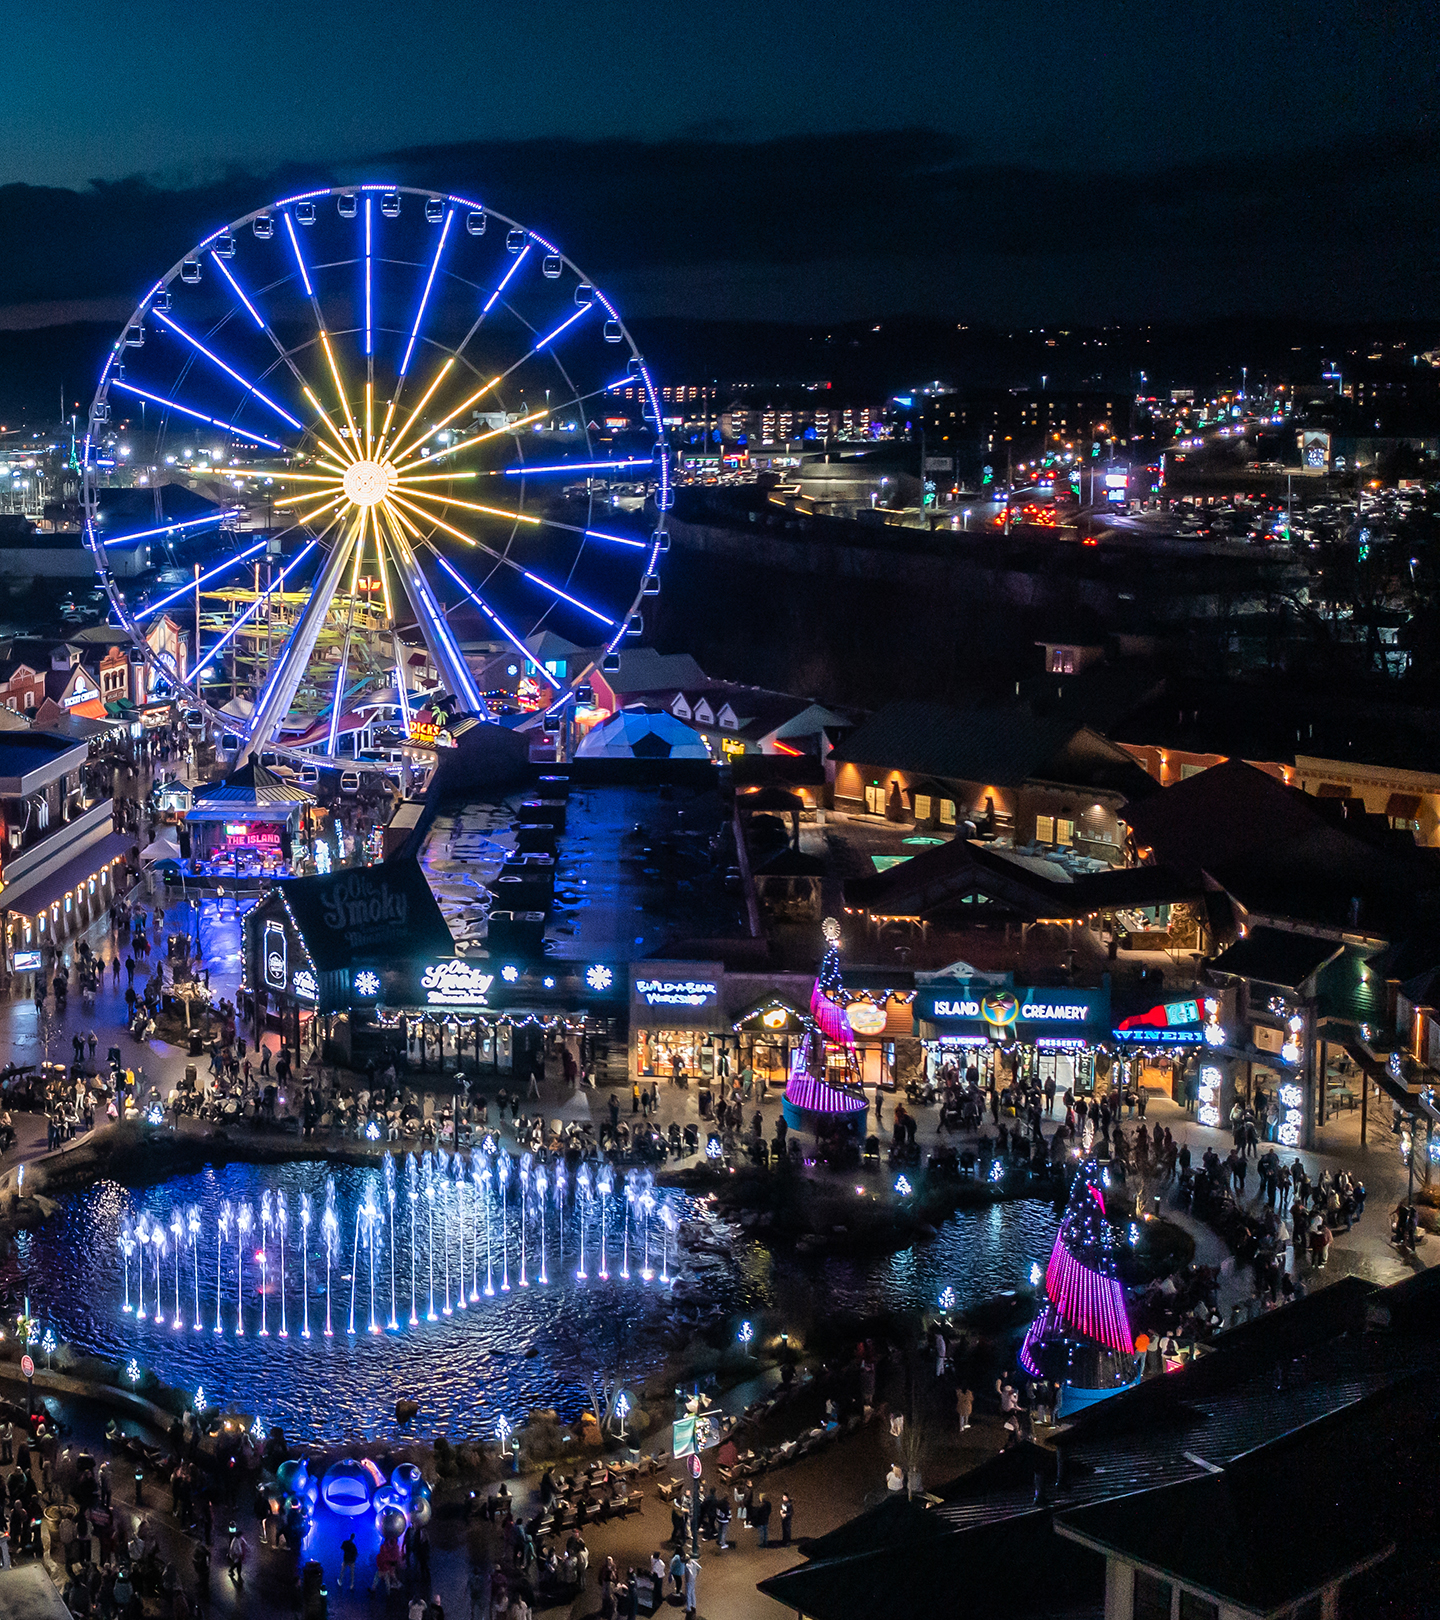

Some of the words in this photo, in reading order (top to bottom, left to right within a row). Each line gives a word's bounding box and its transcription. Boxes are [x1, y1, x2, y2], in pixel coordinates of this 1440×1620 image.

[409, 721, 440, 735] DICK'S
[226, 835, 245, 845] THE
[247, 833, 280, 844] ISLAND
[348, 873, 382, 899] Ole
[321, 883, 408, 930] Smoky
[421, 963, 494, 994] Smoky
[646, 992, 707, 1005] WORKSHOP
[934, 1001, 979, 1016] ISLAND
[1022, 1004, 1088, 1020] CREAMERY
[942, 1036, 987, 1046] DELICIOUS
[1038, 1038, 1084, 1048] DESSERTS
